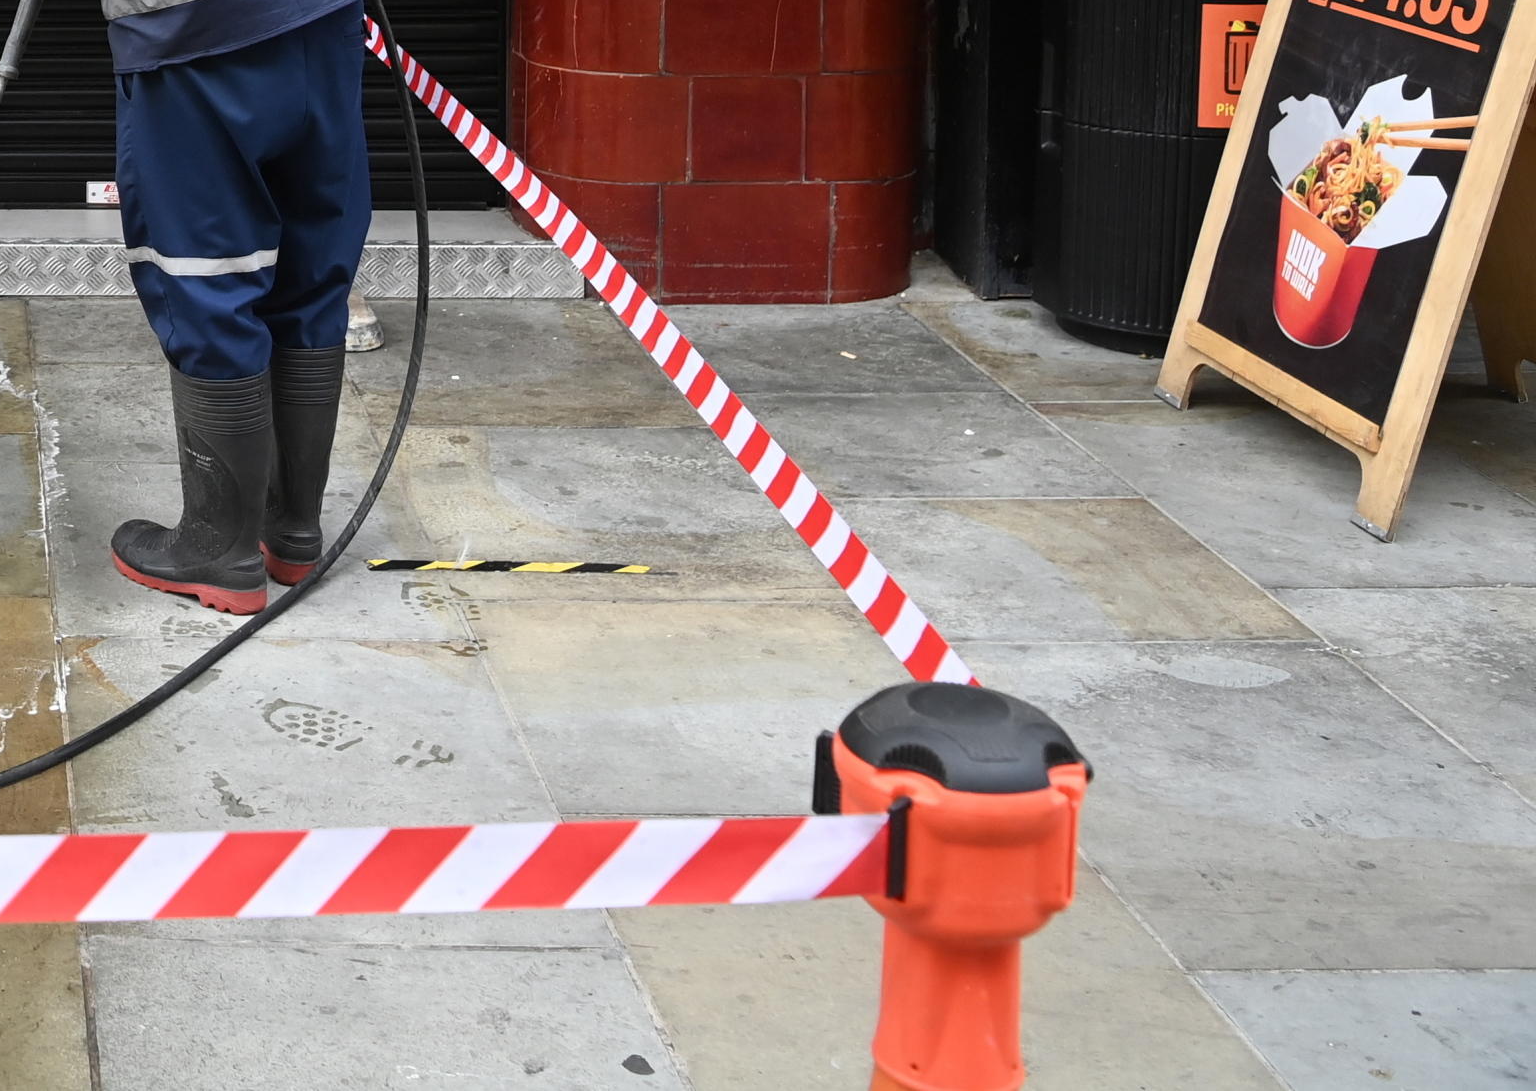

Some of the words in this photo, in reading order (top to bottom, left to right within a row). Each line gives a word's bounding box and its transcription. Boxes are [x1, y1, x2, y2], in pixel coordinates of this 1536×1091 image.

[1281, 260, 1293, 283] TO
[1289, 268, 1315, 302] WALK
[1285, 228, 1327, 285] WOK
